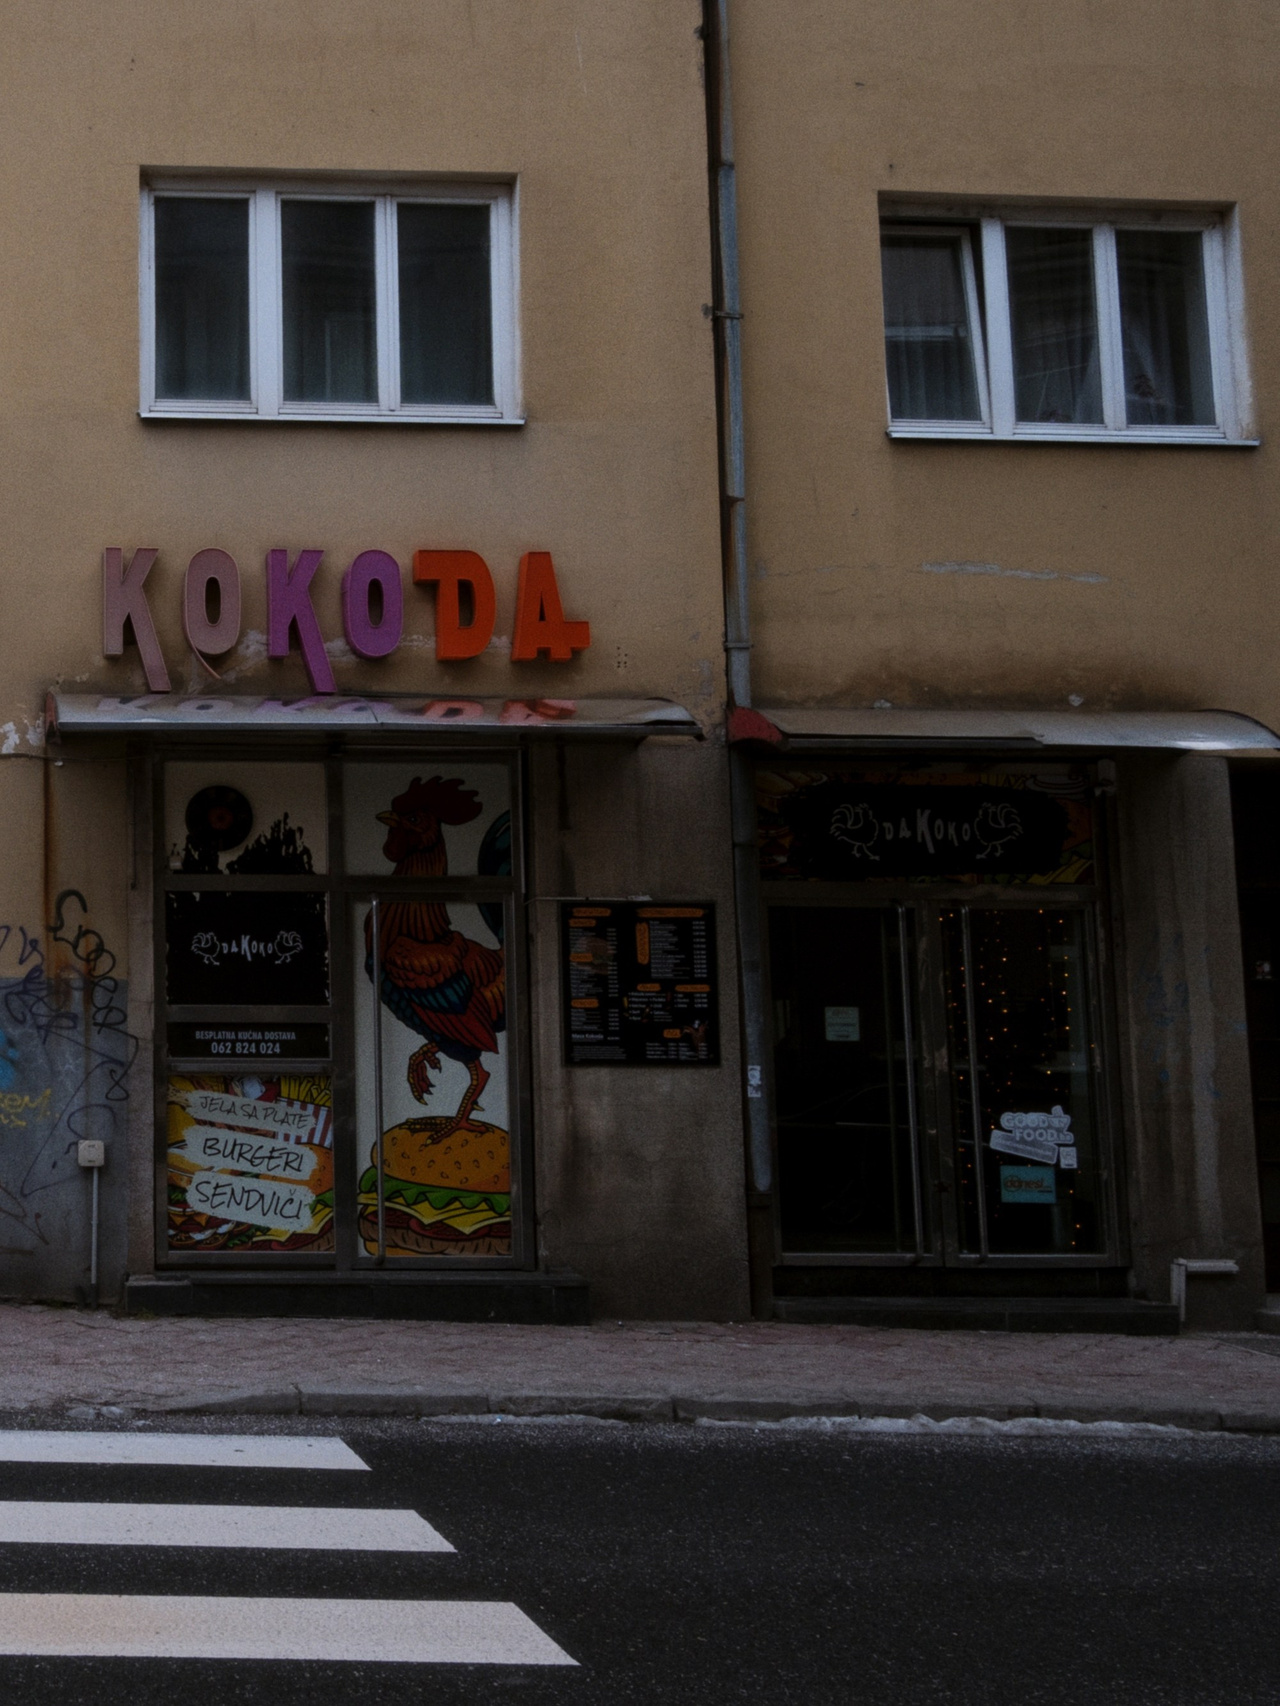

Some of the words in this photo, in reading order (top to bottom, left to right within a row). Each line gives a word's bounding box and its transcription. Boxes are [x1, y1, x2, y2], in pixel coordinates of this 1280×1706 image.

[101, 546, 592, 694] KOKODA
[195, 1030, 236, 1040] BESPLATNA
[264, 1031, 297, 1041] DOSTAVA
[211, 1041, 232, 1054] 062
[235, 1042, 256, 1054] 824
[259, 1042, 281, 1054] 024
[198, 1096, 239, 1118] JELA
[241, 1103, 261, 1121] SA
[262, 1105, 312, 1131] PLATE
[1004, 1114, 1049, 1127] GOOD
[202, 1137, 305, 1173] BURGERI
[194, 1179, 305, 1221] SENDVIČI
